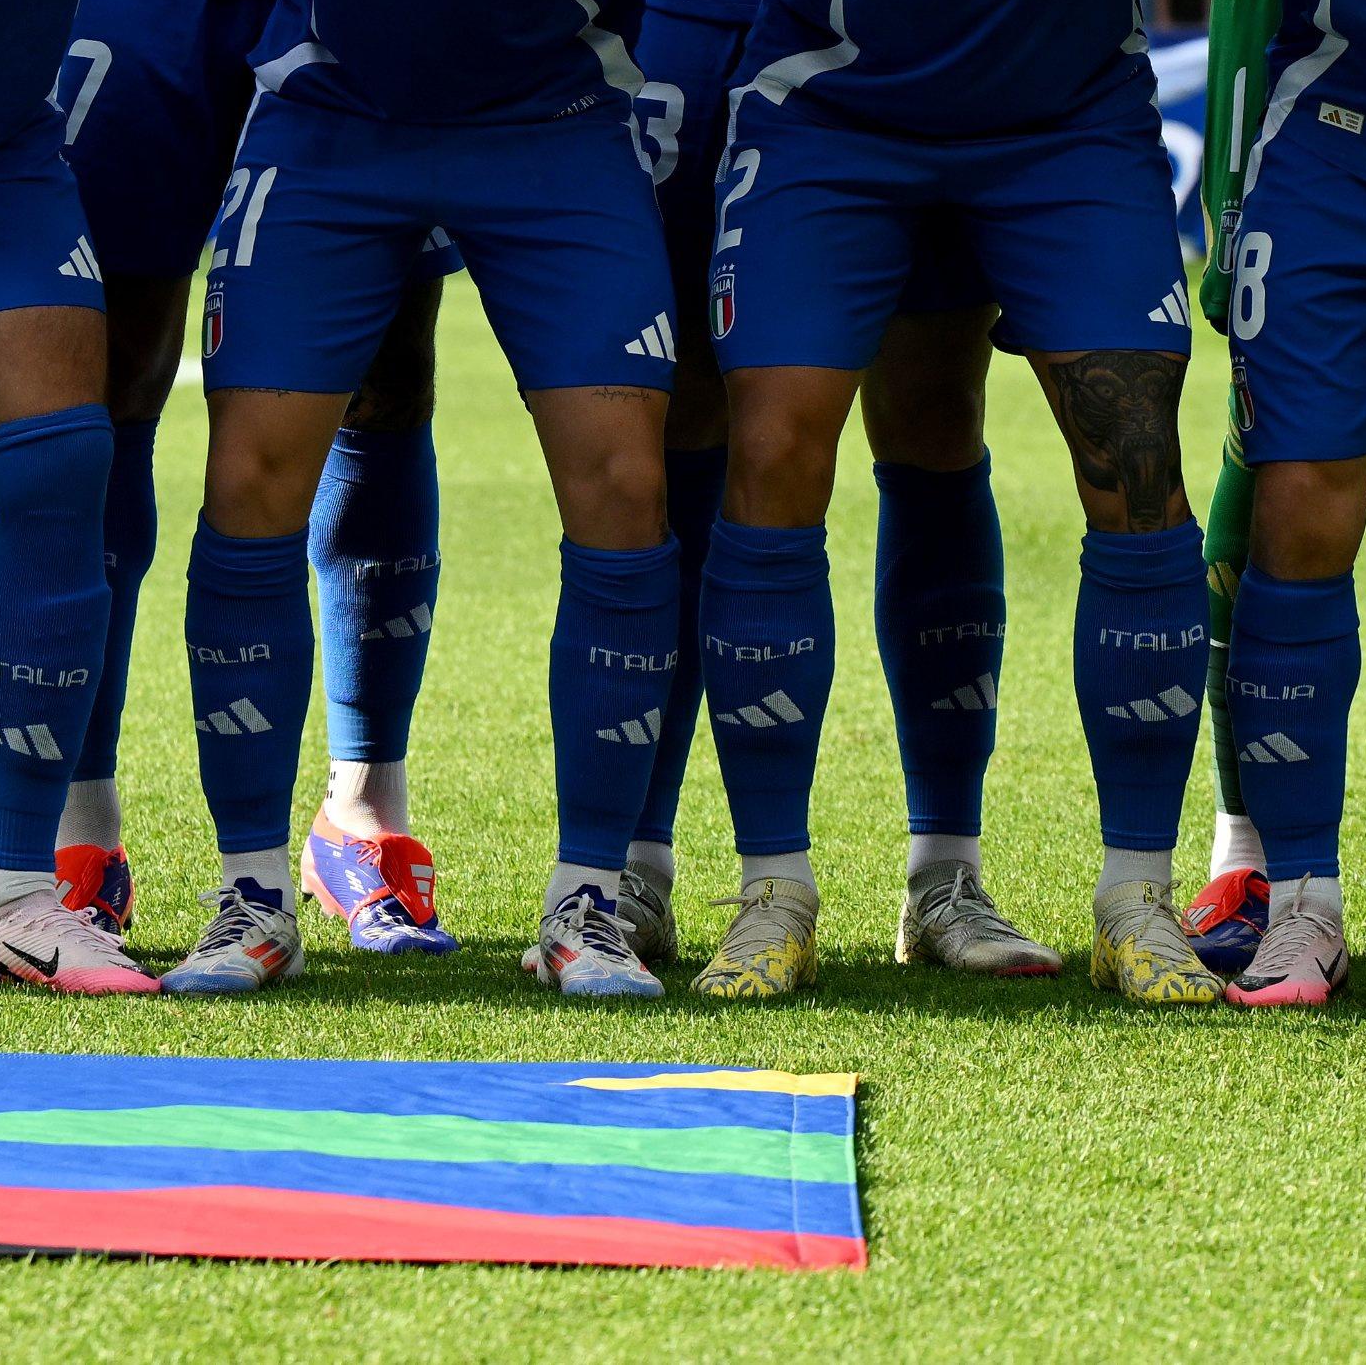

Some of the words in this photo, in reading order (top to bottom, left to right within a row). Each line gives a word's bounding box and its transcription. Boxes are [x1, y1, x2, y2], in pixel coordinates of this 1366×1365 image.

[716, 148, 761, 255] 2
[210, 166, 278, 272] 21
[706, 635, 815, 662] ITALIA
[1100, 624, 1205, 652] ITALIA
[187, 642, 271, 664] TALIA
[589, 646, 679, 671] ITALIA
[1226, 674, 1315, 700] TALIA
